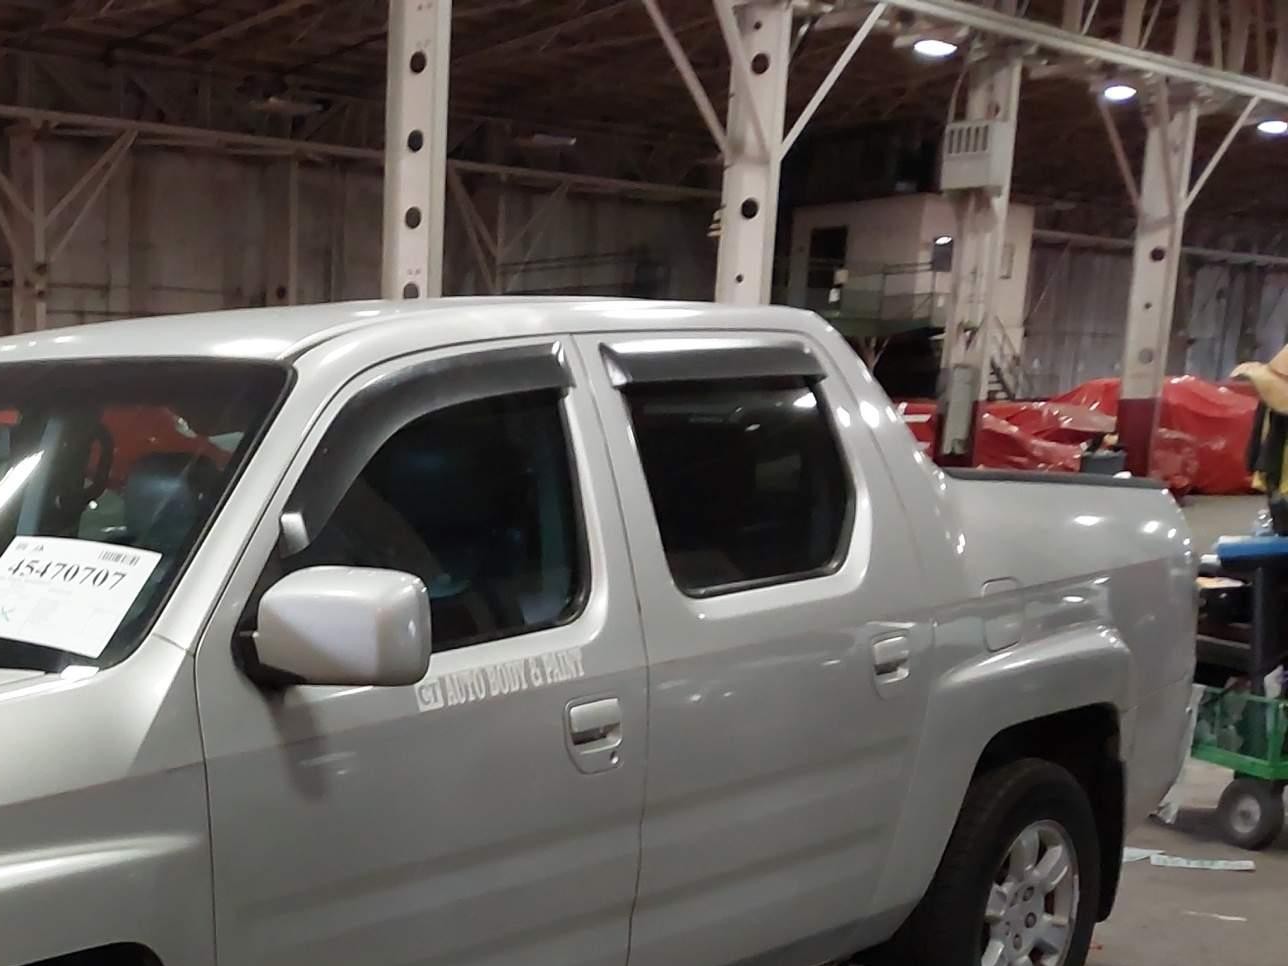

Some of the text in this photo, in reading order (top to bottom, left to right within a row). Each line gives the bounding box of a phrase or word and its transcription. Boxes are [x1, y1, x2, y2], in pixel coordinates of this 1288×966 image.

[7, 557, 128, 592] 45470707
[446, 671, 486, 706] AUTO
[488, 660, 528, 696] BODY
[530, 659, 543, 687] &
[544, 649, 585, 684] PAINT
